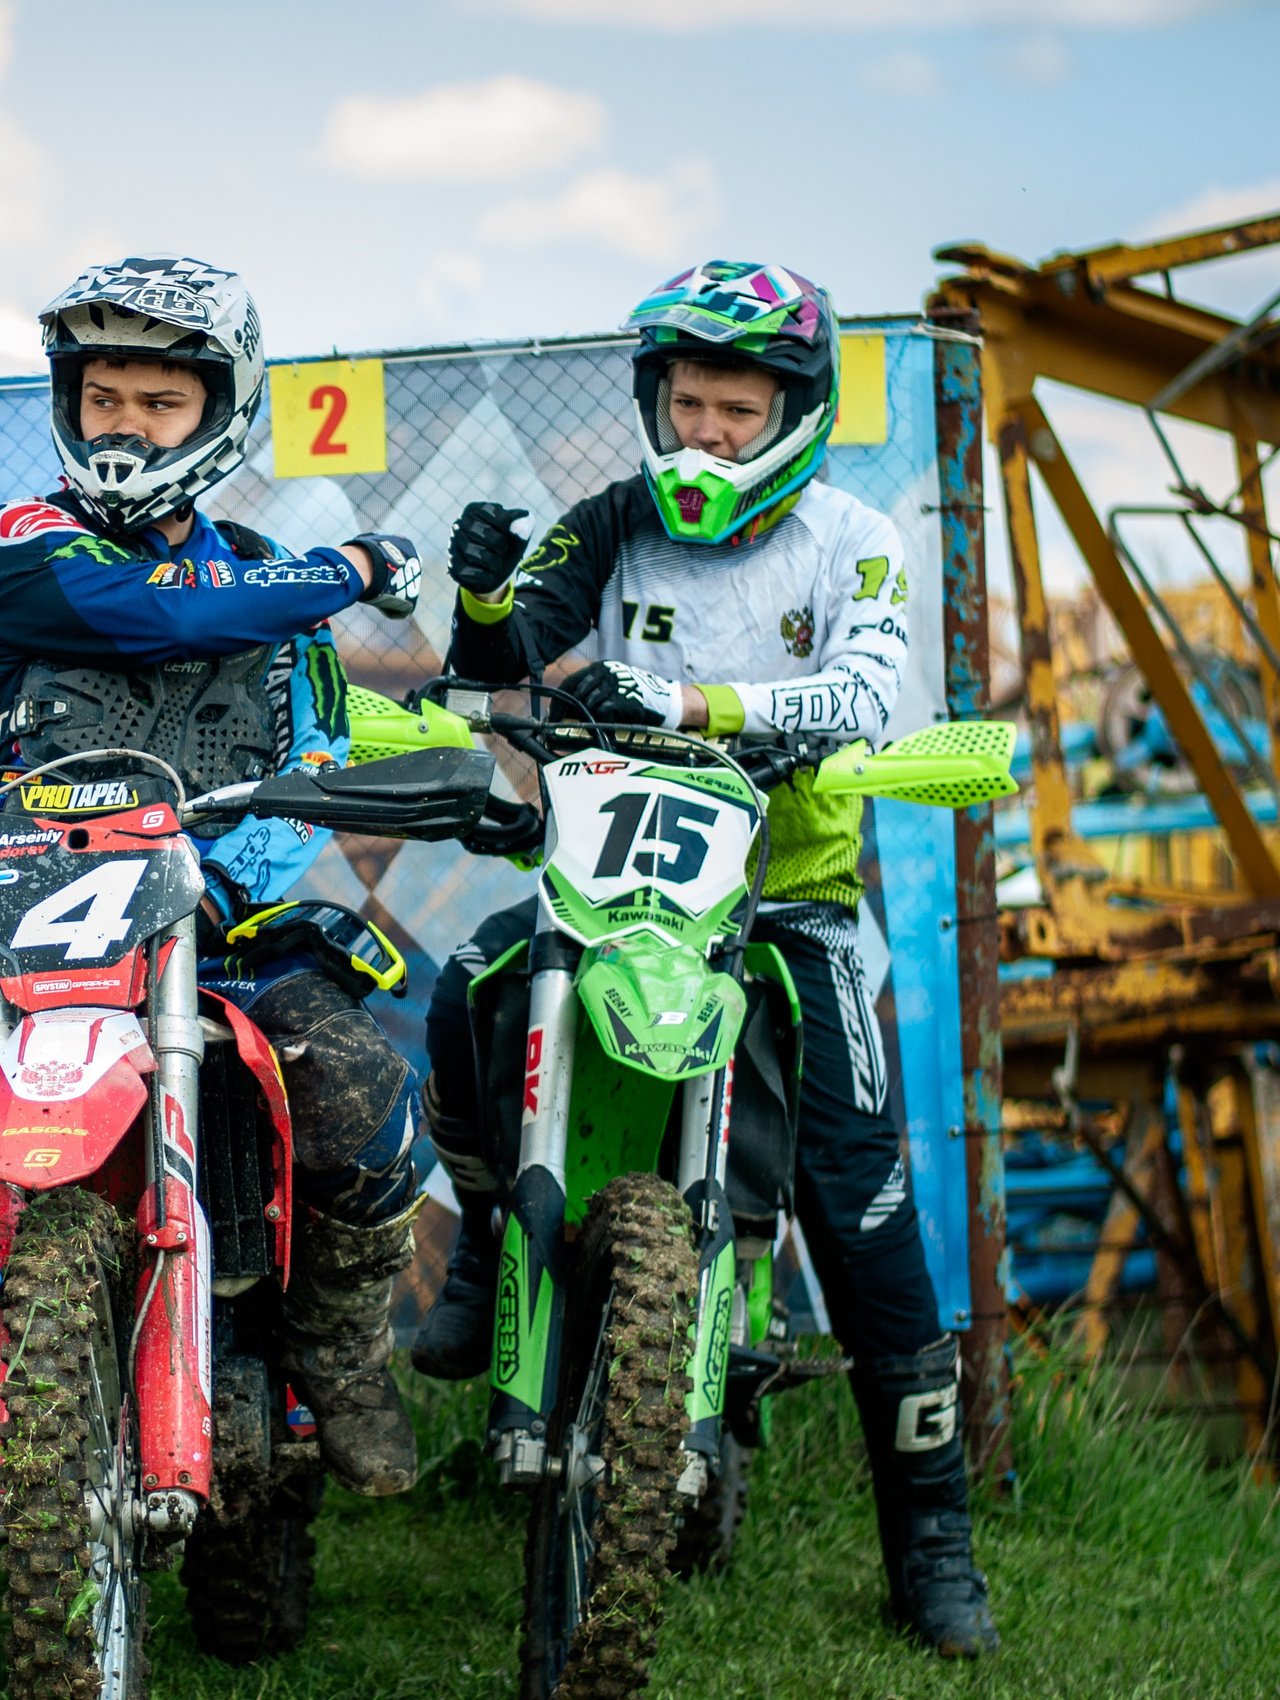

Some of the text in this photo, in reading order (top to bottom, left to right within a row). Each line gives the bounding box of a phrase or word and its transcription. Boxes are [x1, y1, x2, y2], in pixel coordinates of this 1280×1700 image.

[309, 385, 348, 455] 2
[164, 661, 208, 675] LEATT
[771, 681, 860, 735] FOX
[558, 760, 630, 777] MXGP
[29, 782, 132, 809] PROTAPER
[684, 772, 744, 796] ACERBIS
[592, 792, 720, 885] 15
[9, 858, 150, 961] 4
[607, 908, 684, 933] Kawasaki
[35, 979, 120, 992] SPYSTAV GRAPHICS
[624, 1042, 711, 1061] Kawasaki
[1, 1126, 89, 1137] GASGAS
[496, 1250, 521, 1385] ACERBIS
